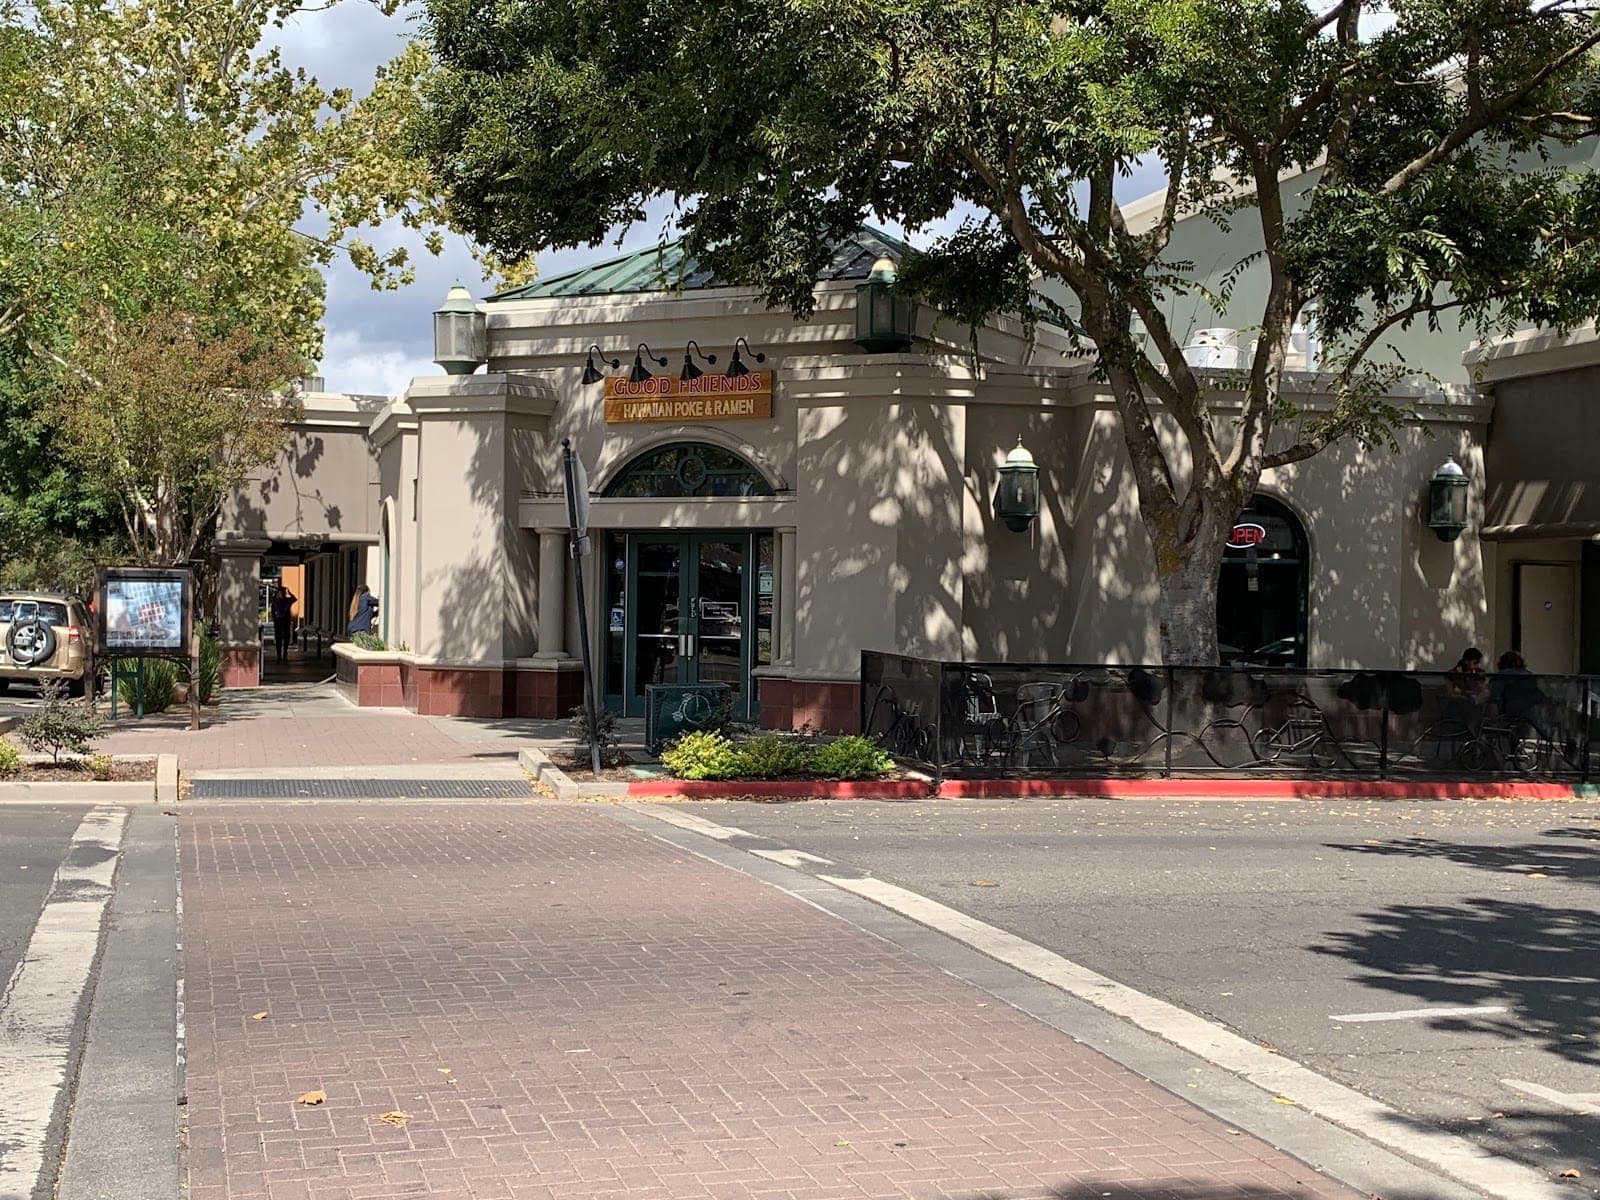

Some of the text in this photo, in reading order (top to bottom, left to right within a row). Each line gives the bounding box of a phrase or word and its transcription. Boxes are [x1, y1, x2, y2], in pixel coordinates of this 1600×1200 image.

[614, 373, 762, 396] GOOD FRIENDS
[623, 400, 754, 419] HAWAIIAN POKE & RAMEN
